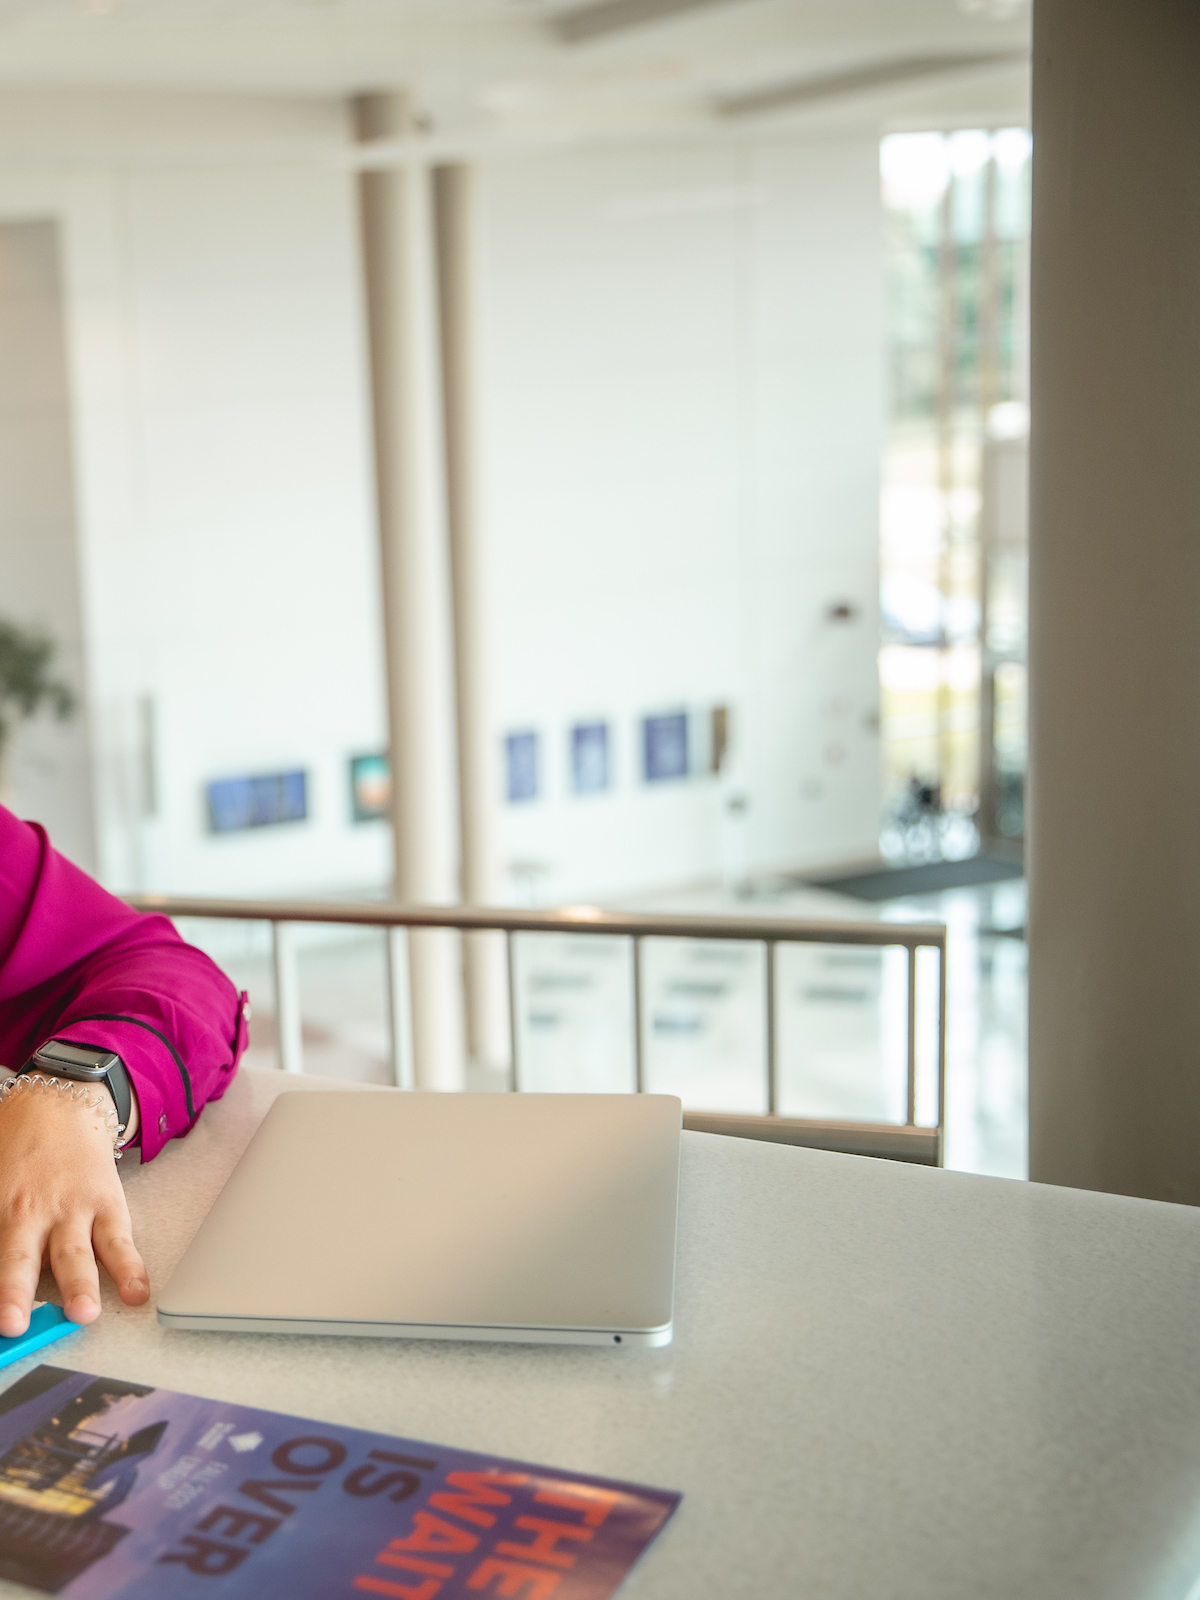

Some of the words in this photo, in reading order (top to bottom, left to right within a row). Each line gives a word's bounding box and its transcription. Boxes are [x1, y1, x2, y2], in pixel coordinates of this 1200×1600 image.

[156, 1436, 347, 1578] OVER
[342, 1448, 438, 1503] IS
[351, 1470, 531, 1600] WAIT
[466, 1482, 618, 1600] THE
